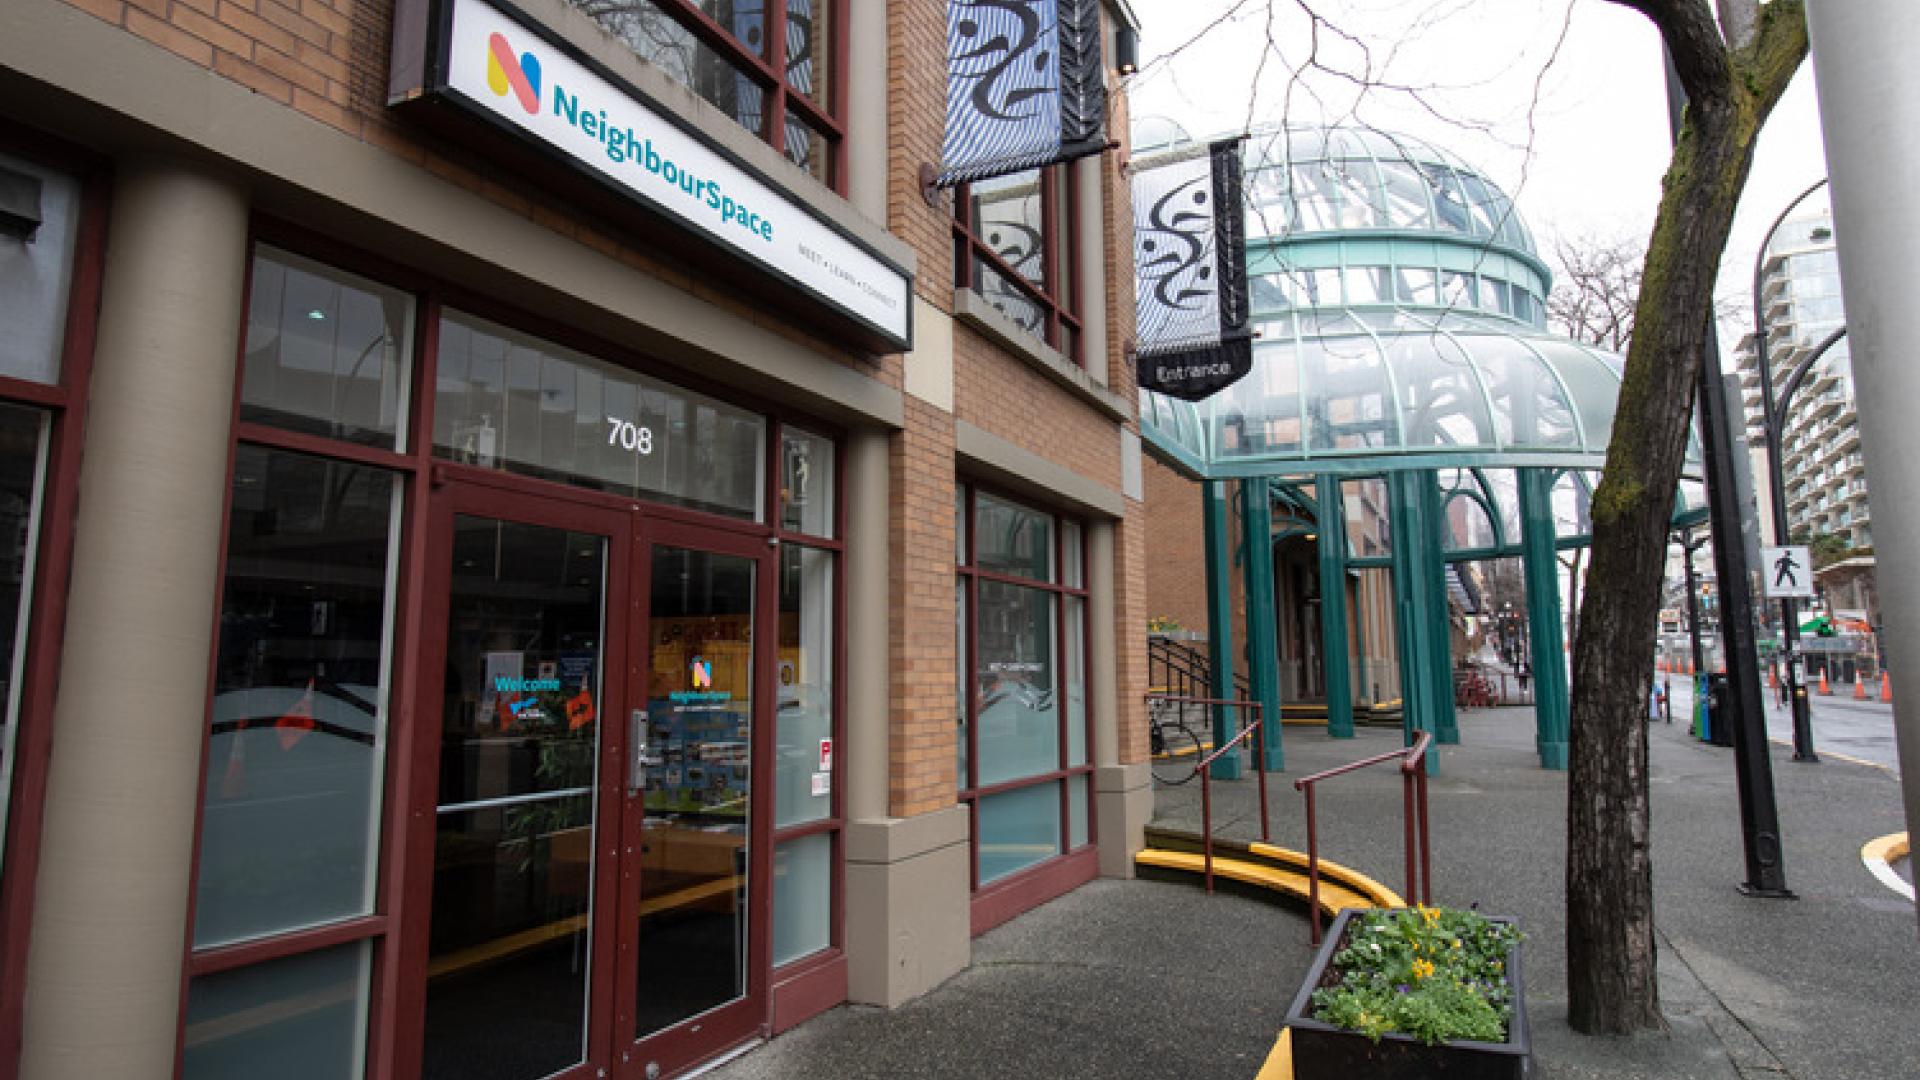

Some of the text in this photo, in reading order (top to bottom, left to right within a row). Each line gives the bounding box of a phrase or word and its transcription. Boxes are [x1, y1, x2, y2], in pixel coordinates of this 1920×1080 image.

[553, 84, 773, 242] NeighbourSpace
[1157, 363, 1230, 382] Entrance
[608, 417, 651, 454] 708
[495, 675, 561, 692] Welcome
